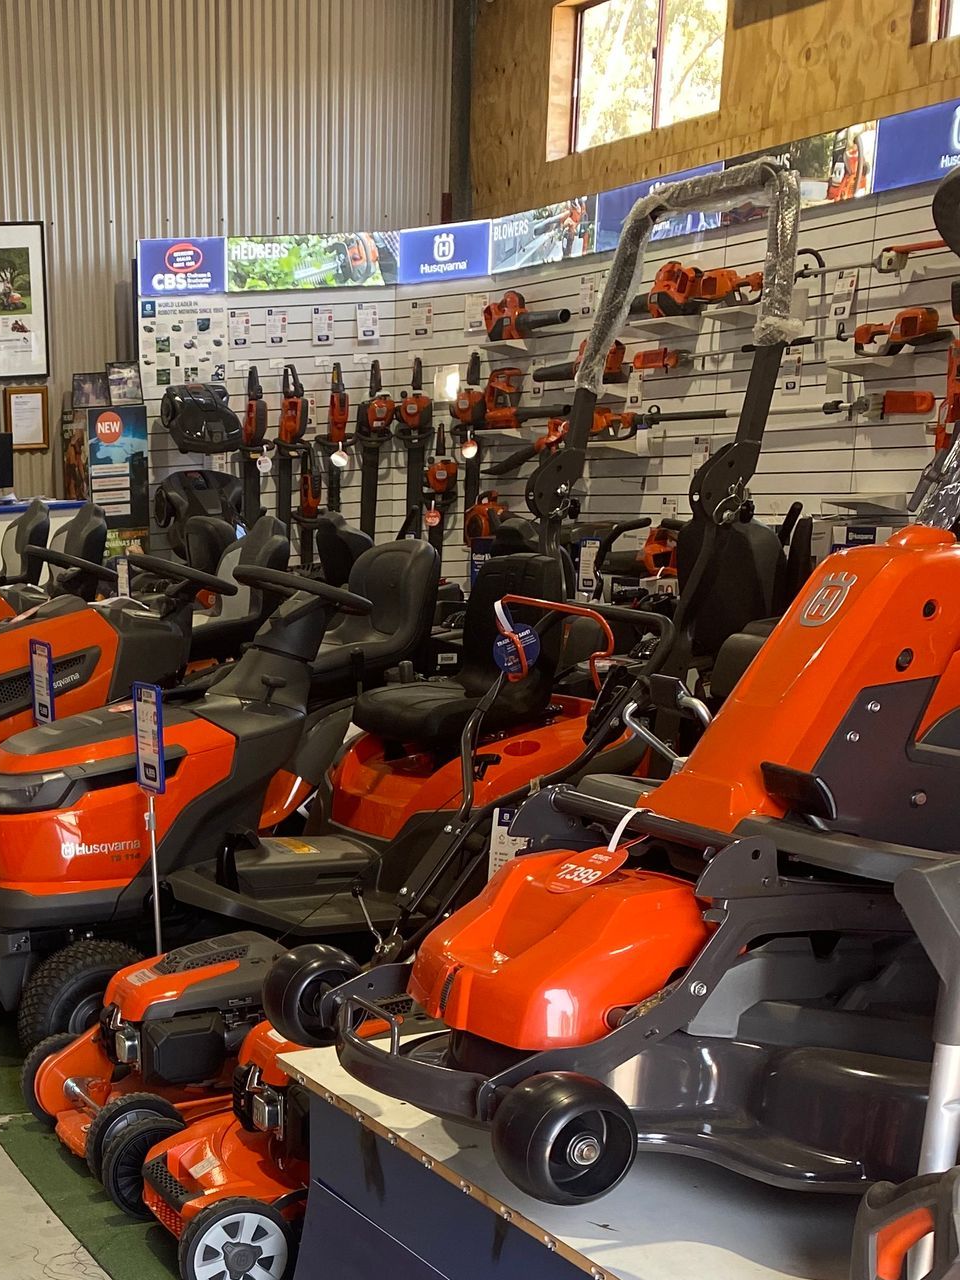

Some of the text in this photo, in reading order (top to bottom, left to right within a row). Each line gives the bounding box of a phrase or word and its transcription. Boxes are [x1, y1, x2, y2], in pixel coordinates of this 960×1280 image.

[493, 219, 529, 241] BLOWERS
[232, 242, 289, 261] HEDGERS
[420, 260, 467, 274] Husqvarna
[152, 273, 187, 290] CBS
[96, 422, 120, 433] NEW
[53, 673, 80, 689] sqvarna
[76, 840, 141, 855] Husqvarna
